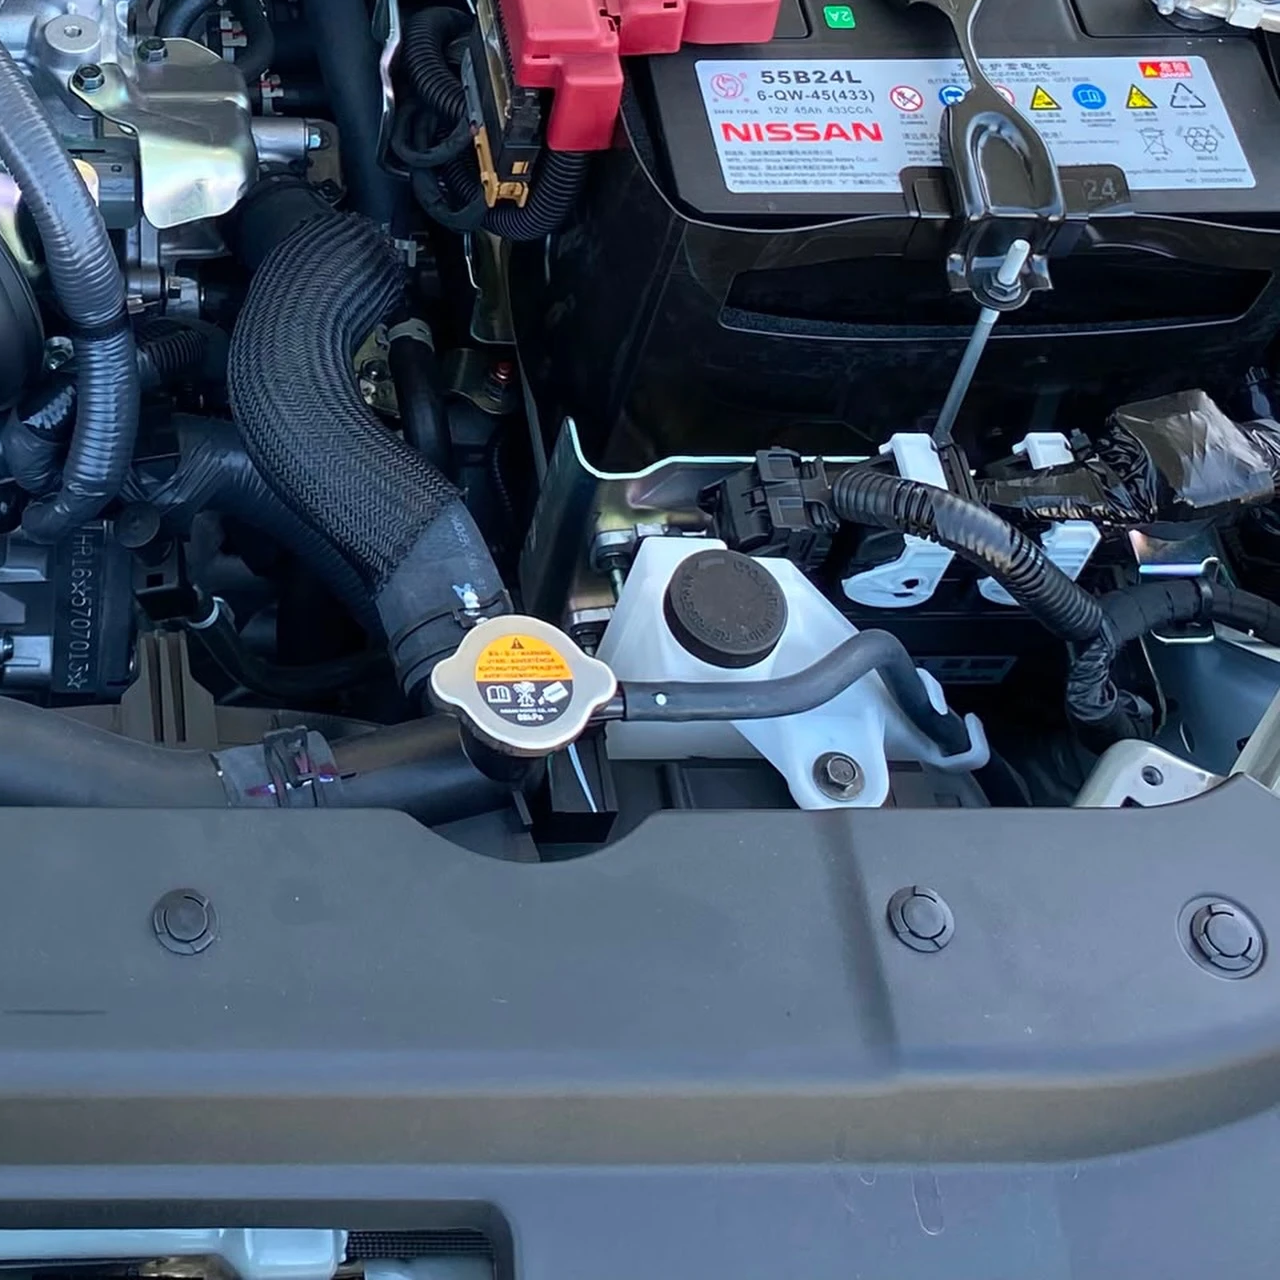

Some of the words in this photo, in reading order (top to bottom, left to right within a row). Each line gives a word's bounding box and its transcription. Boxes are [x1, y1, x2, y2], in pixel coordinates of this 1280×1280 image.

[760, 70, 862, 85] 55B24L
[756, 89, 876, 104] 6-QW-45(433)
[768, 106, 788, 115] 12V
[721, 122, 884, 142] NISSAN
[1086, 178, 1117, 201] 24
